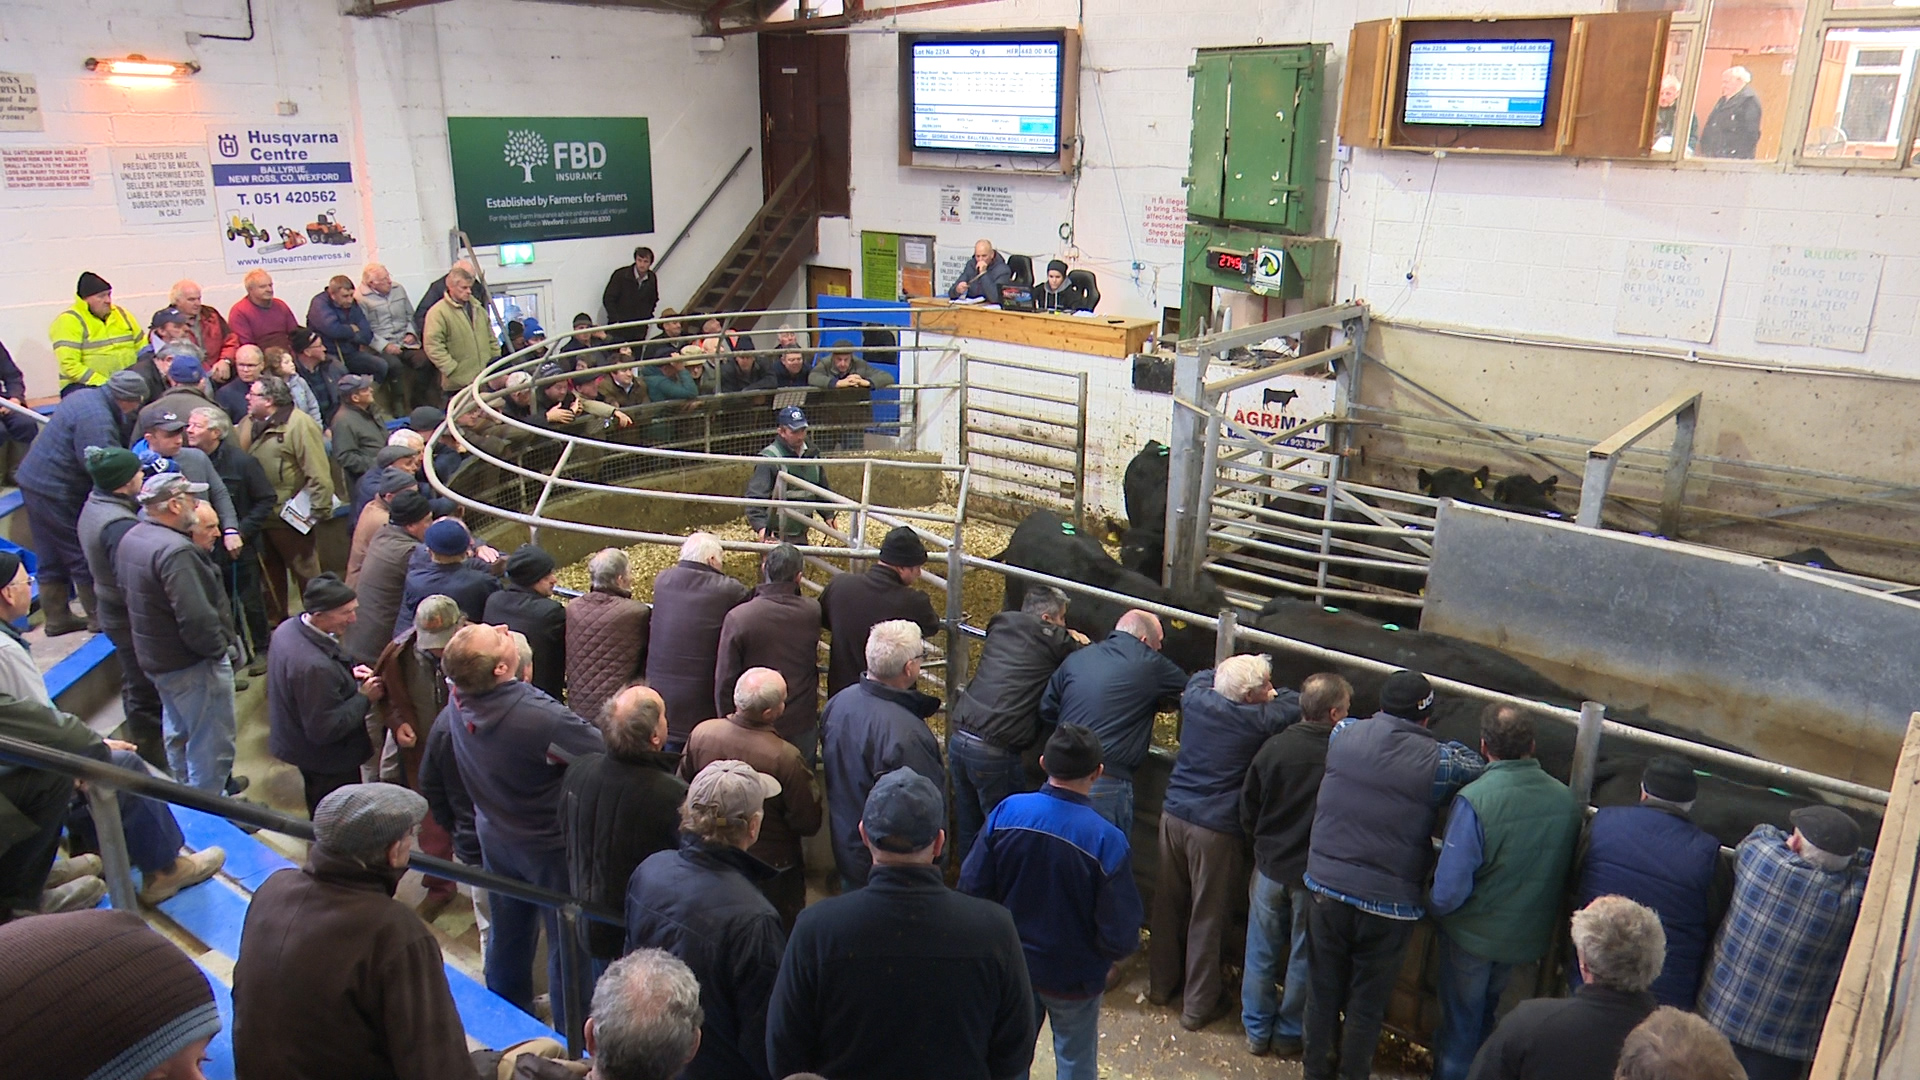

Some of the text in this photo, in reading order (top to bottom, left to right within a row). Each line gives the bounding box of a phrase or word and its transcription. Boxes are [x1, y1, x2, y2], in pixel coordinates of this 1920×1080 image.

[248, 131, 338, 146] Husqvarna
[148, 152, 174, 160] HEIFERS
[250, 148, 308, 160] Centre
[554, 141, 607, 170] FBD
[122, 162, 157, 170] PRESUMED
[120, 170, 205, 180] UNLESS OTHERWISE STATED
[298, 173, 339, 181] WEXFORD
[556, 172, 602, 182] INSURANCE
[170, 180, 204, 188] THEREFORE
[164, 190, 181, 198] SUCH
[182, 189, 206, 197] HEIFERS
[237, 191, 336, 205] T. 051 420562
[132, 199, 204, 209] SUBSEQUENTLY PROVEN
[486, 192, 627, 208] Established by Farmers for Farmers
[1166, 198, 1185, 206] illegal
[1148, 229, 1168, 237] Sheep
[237, 253, 350, 266] www.husqvarnanewross.ie
